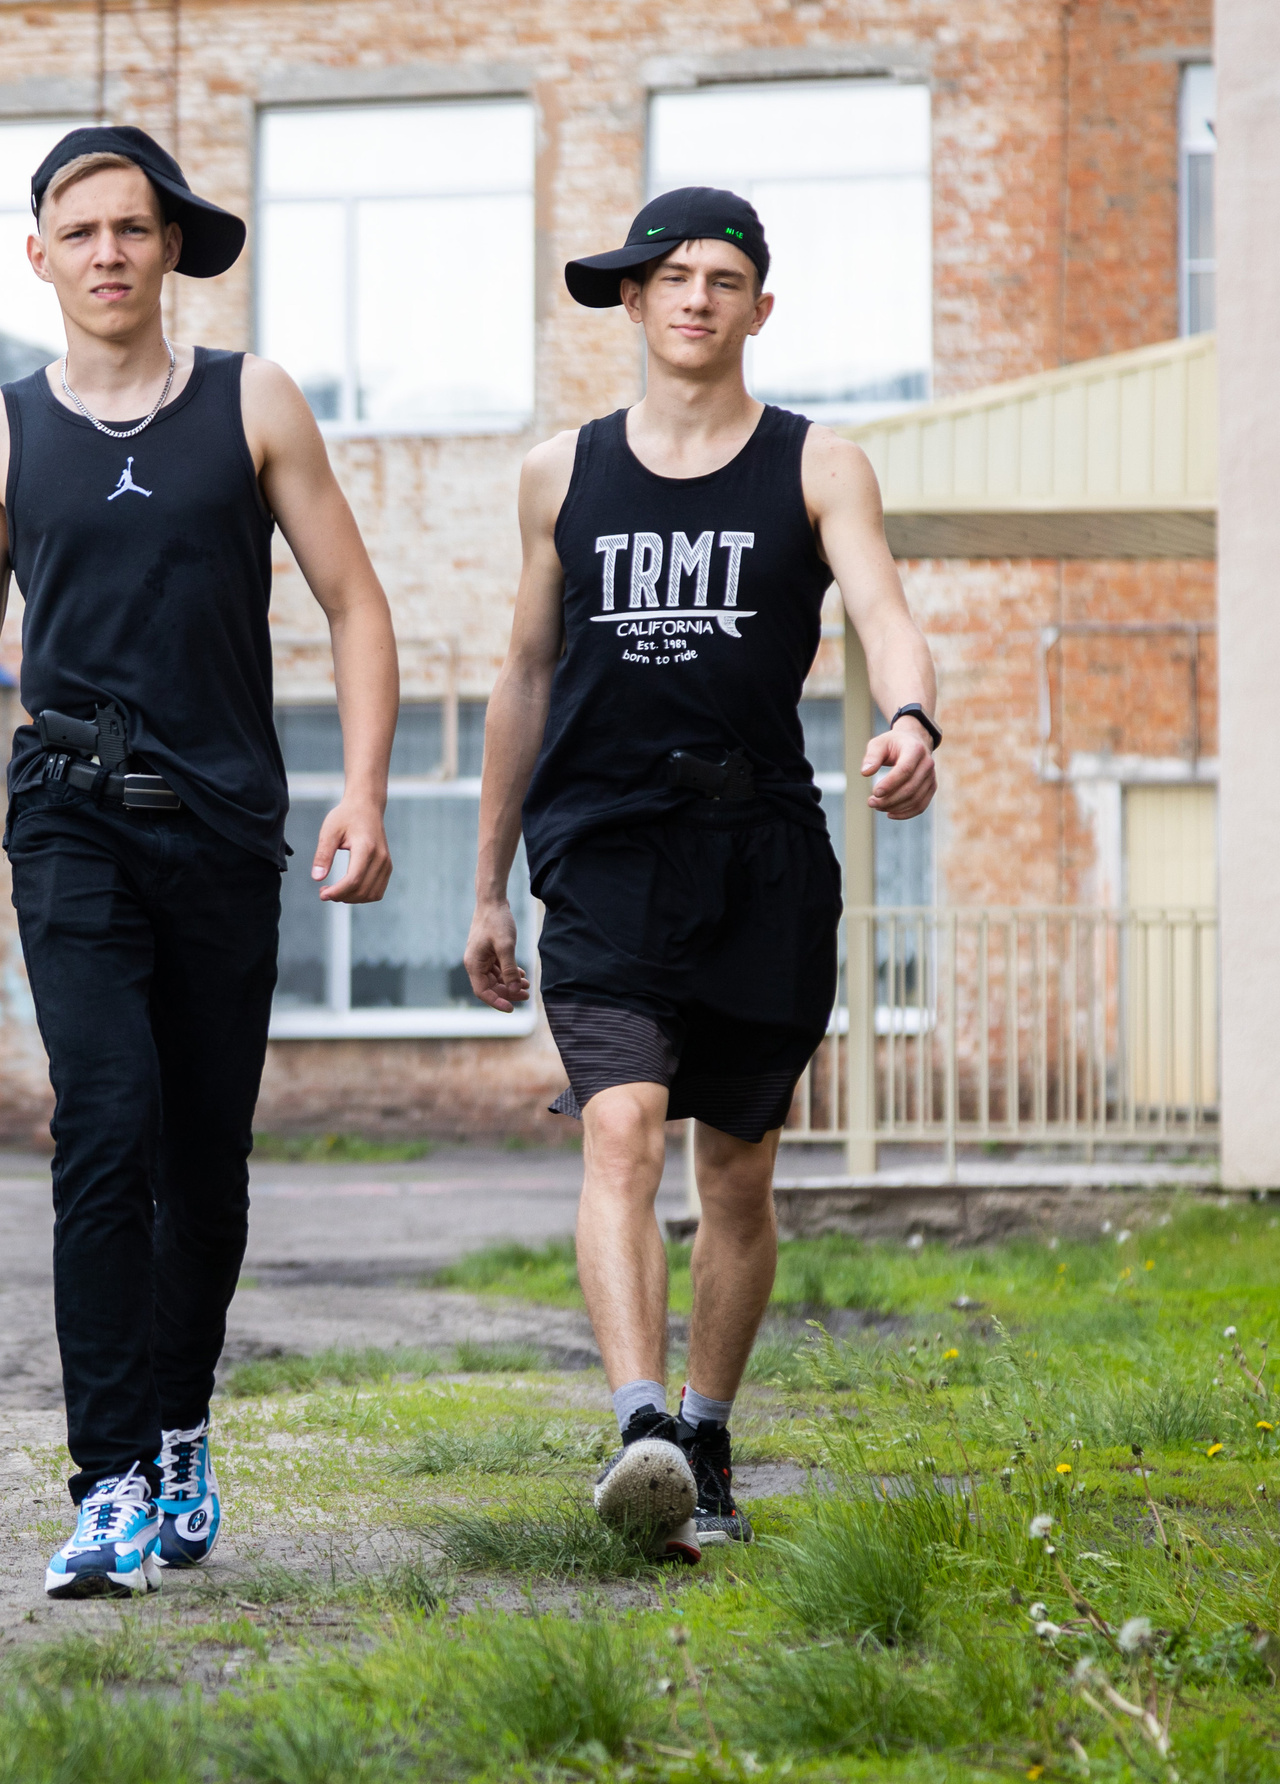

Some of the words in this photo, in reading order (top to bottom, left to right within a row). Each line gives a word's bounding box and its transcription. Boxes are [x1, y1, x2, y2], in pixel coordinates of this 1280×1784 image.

[595, 531, 755, 610] TRMT
[616, 620, 714, 637] CALIFORNIA
[637, 640, 659, 651] Est.
[663, 639, 687, 649] 1989
[622, 649, 650, 664] born
[655, 654, 670, 665] to
[674, 649, 699, 664] ride
